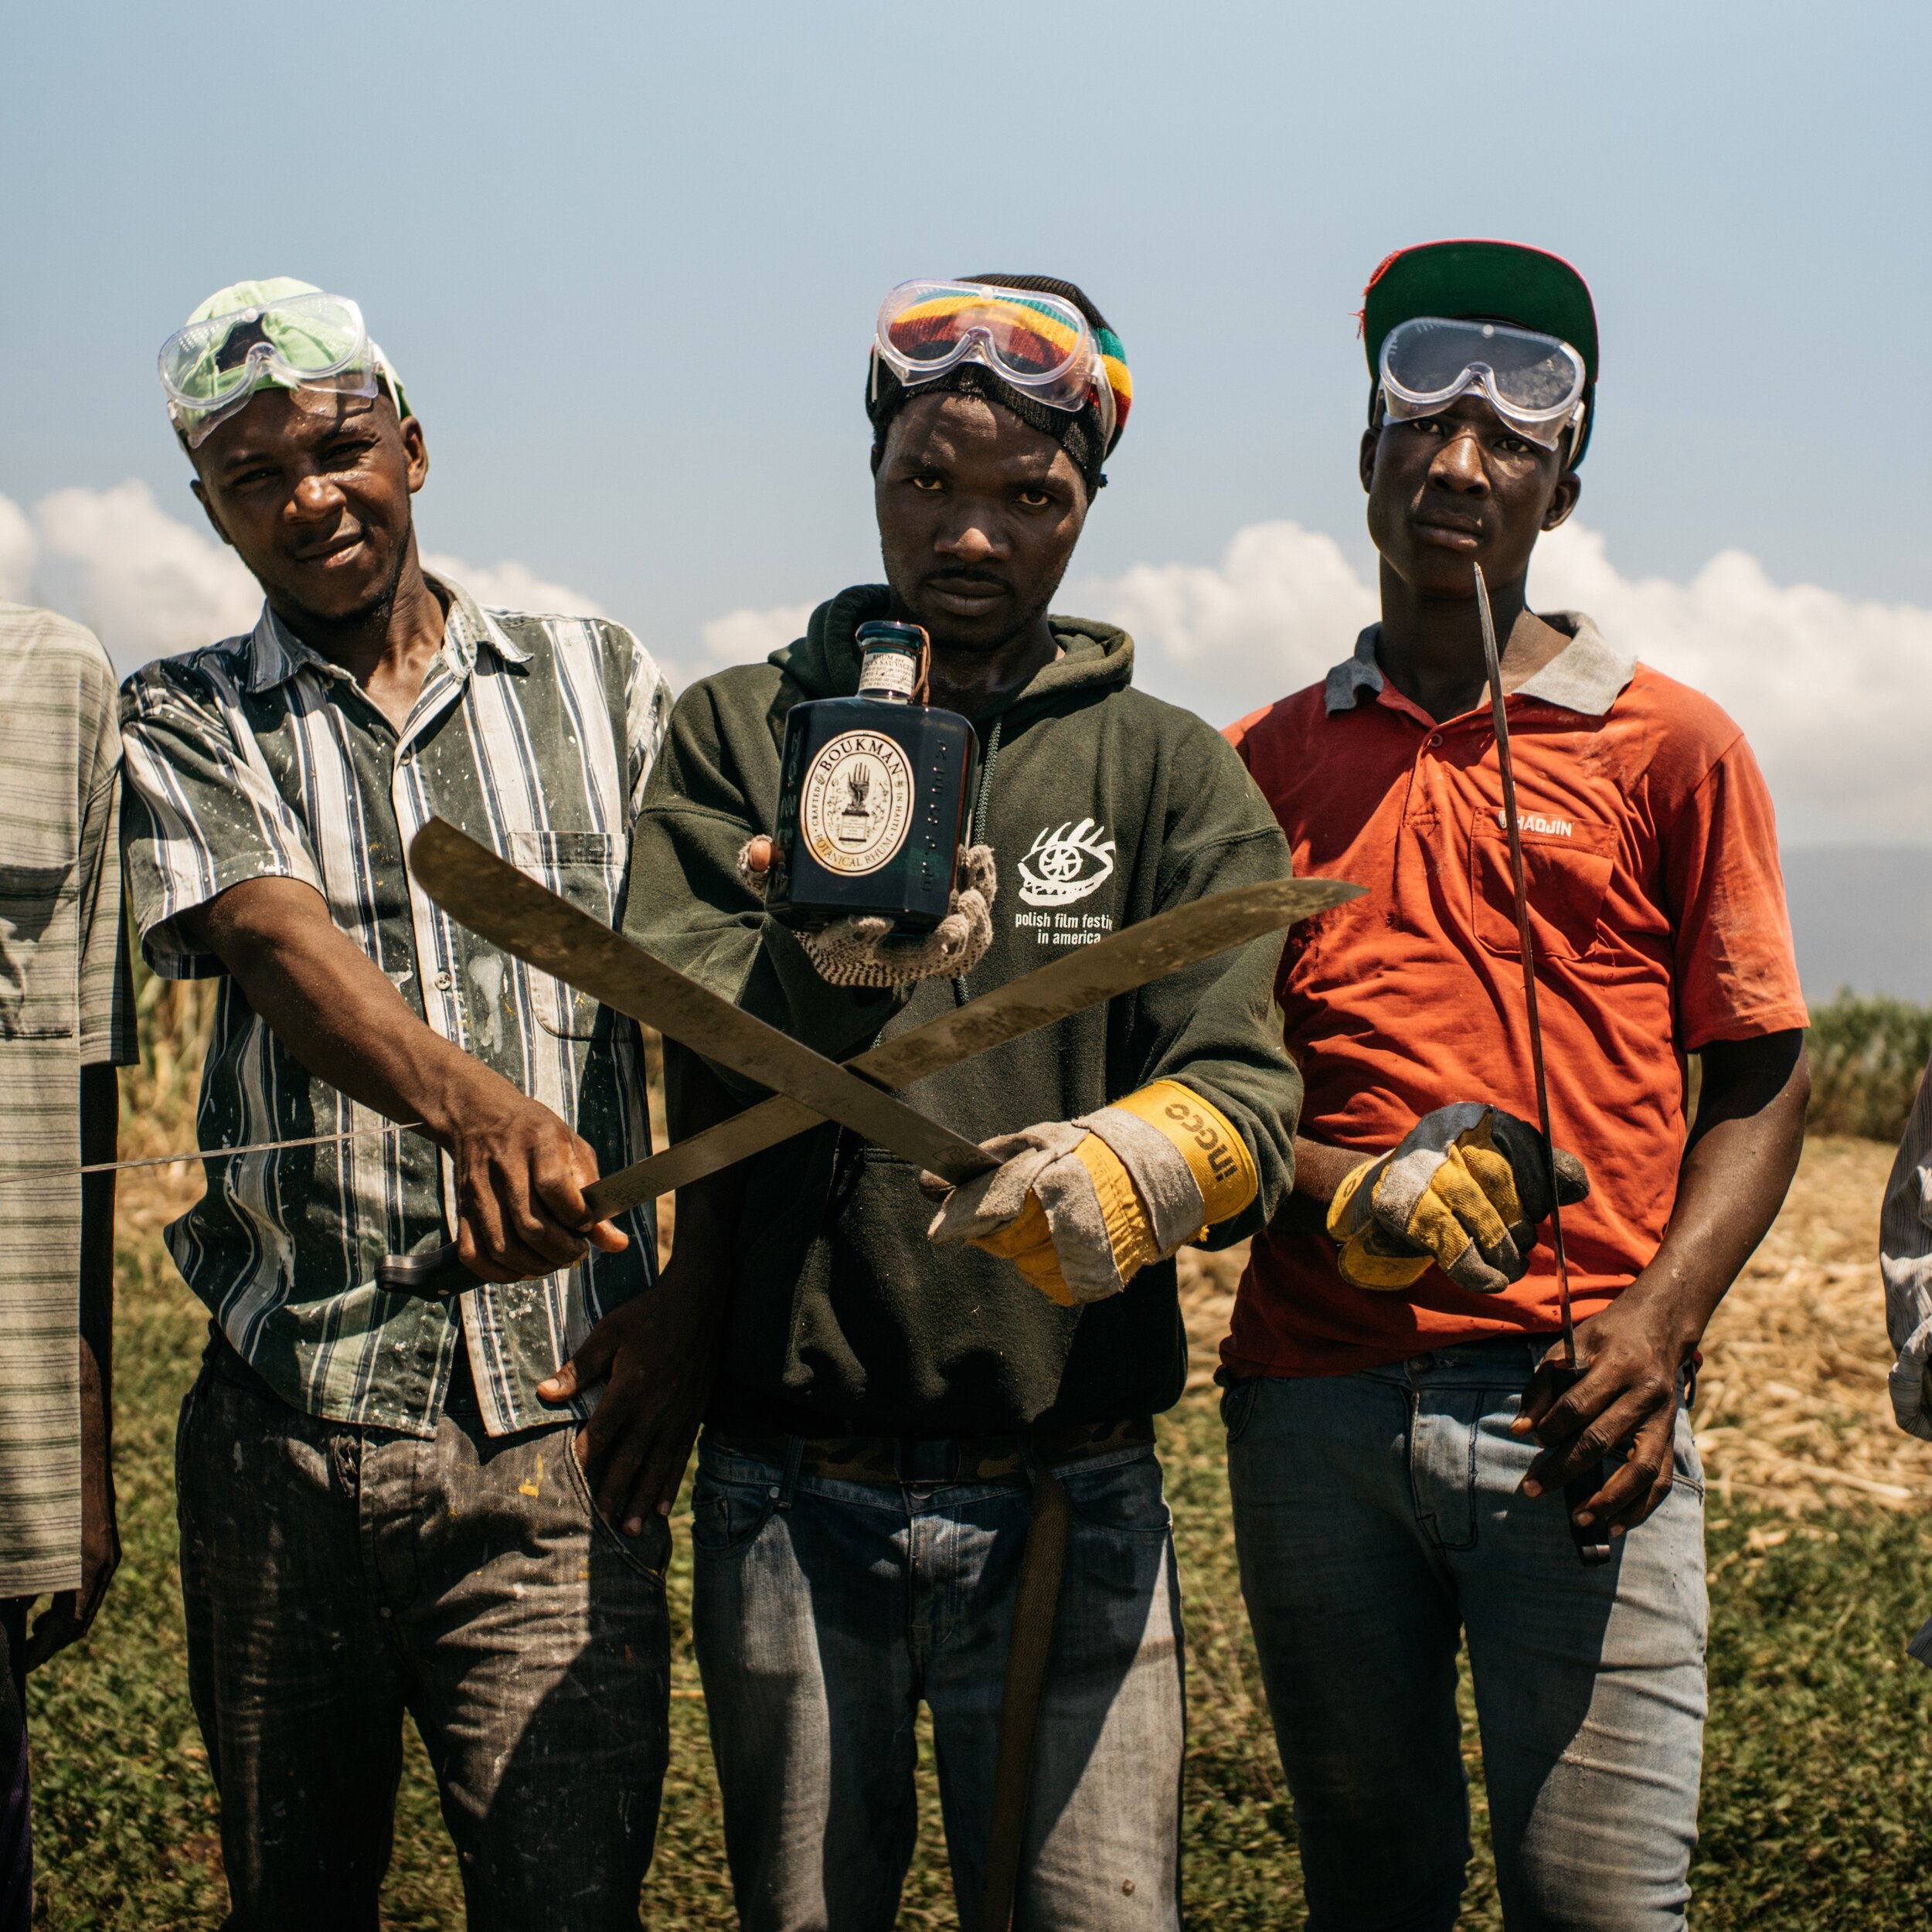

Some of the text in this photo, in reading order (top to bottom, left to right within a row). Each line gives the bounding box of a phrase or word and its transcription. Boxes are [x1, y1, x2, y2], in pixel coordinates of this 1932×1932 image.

[820, 738, 903, 776] BOUKMAN
[811, 786, 821, 827] CRAFTED
[893, 792, 903, 832] IN HAITI
[814, 833, 893, 867] BOTANICAL RHUM
[1015, 912, 1051, 927] polish
[1055, 913, 1079, 928] film
[1037, 929, 1100, 944] in america
